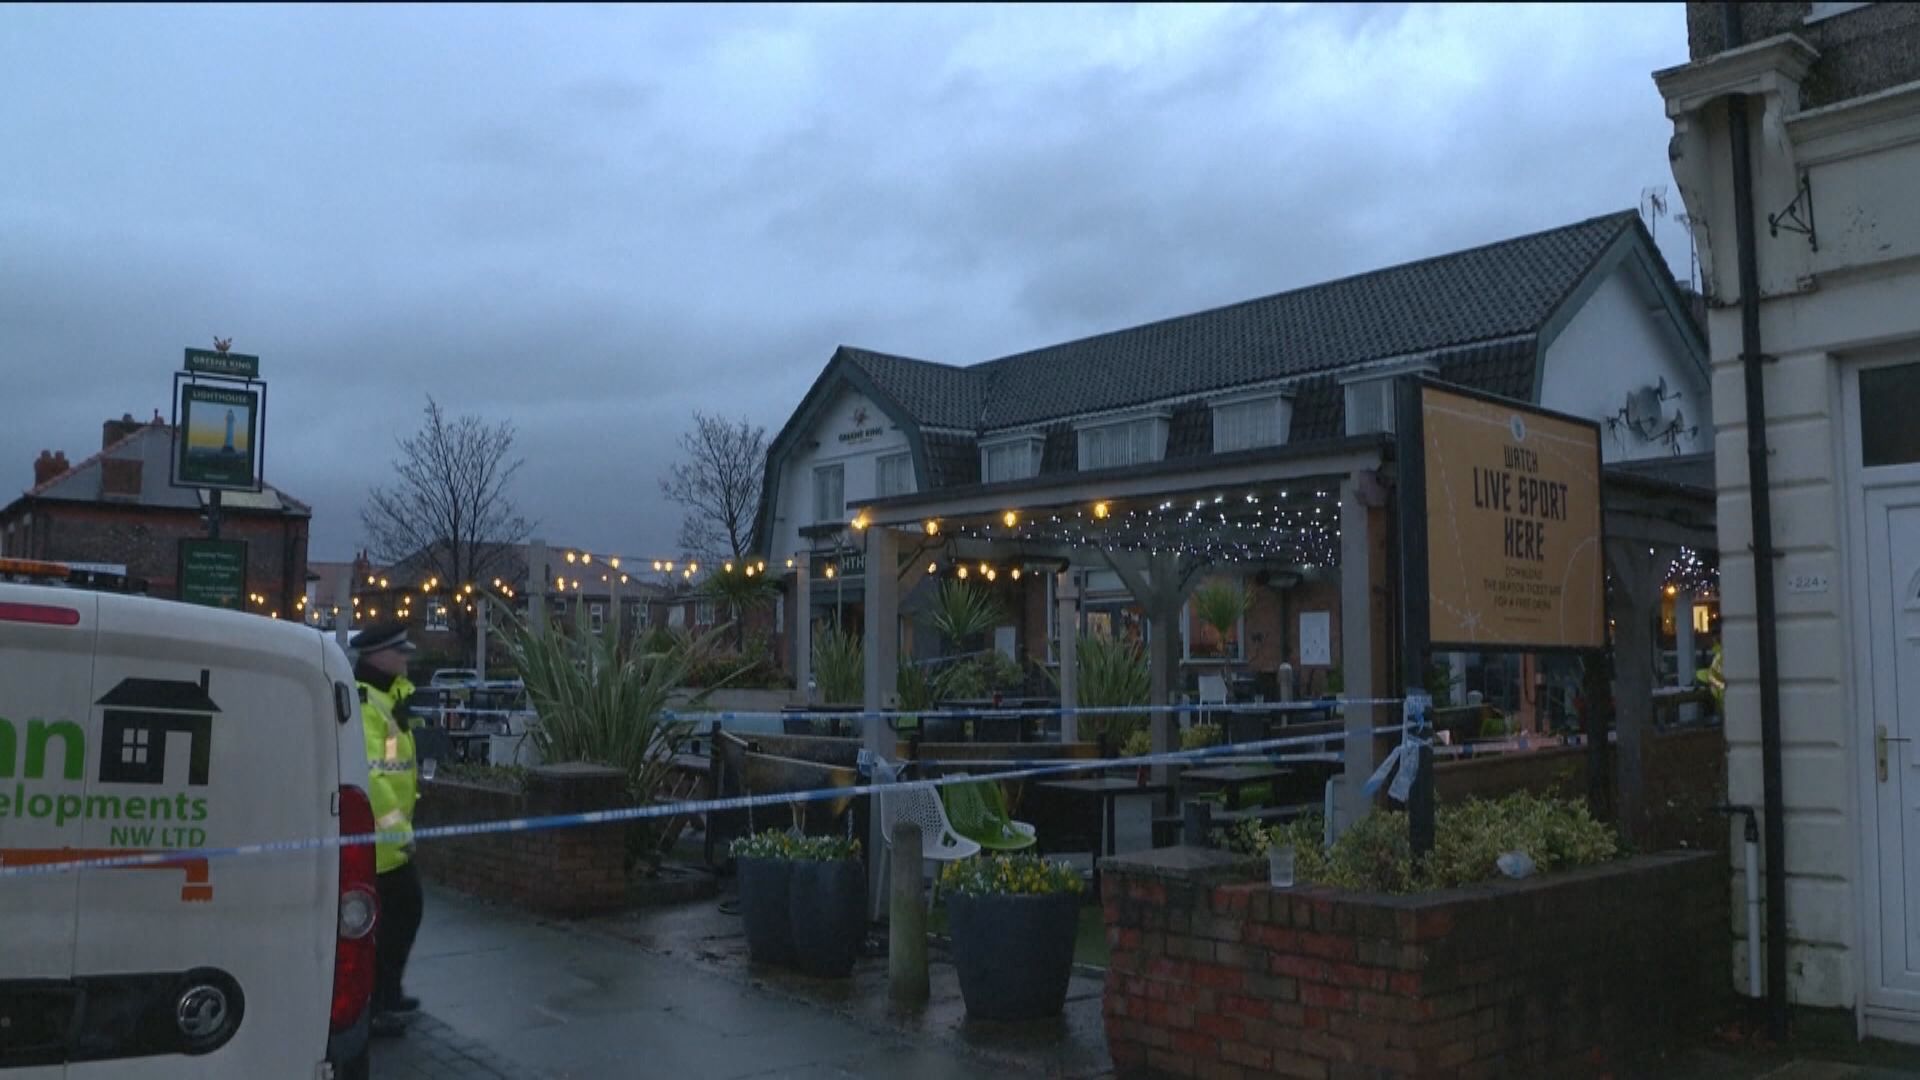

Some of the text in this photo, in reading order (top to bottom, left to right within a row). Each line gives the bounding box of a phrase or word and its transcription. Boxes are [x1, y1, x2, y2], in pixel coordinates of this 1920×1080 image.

[229, 359, 251, 369] KING
[192, 390, 249, 403] LIGHTHOUSE
[1503, 445, 1539, 473] WATCH
[1473, 466, 1568, 521] LIVE SPORT
[1503, 517, 1545, 561] HERE
[110, 826, 206, 847] NW LTD
